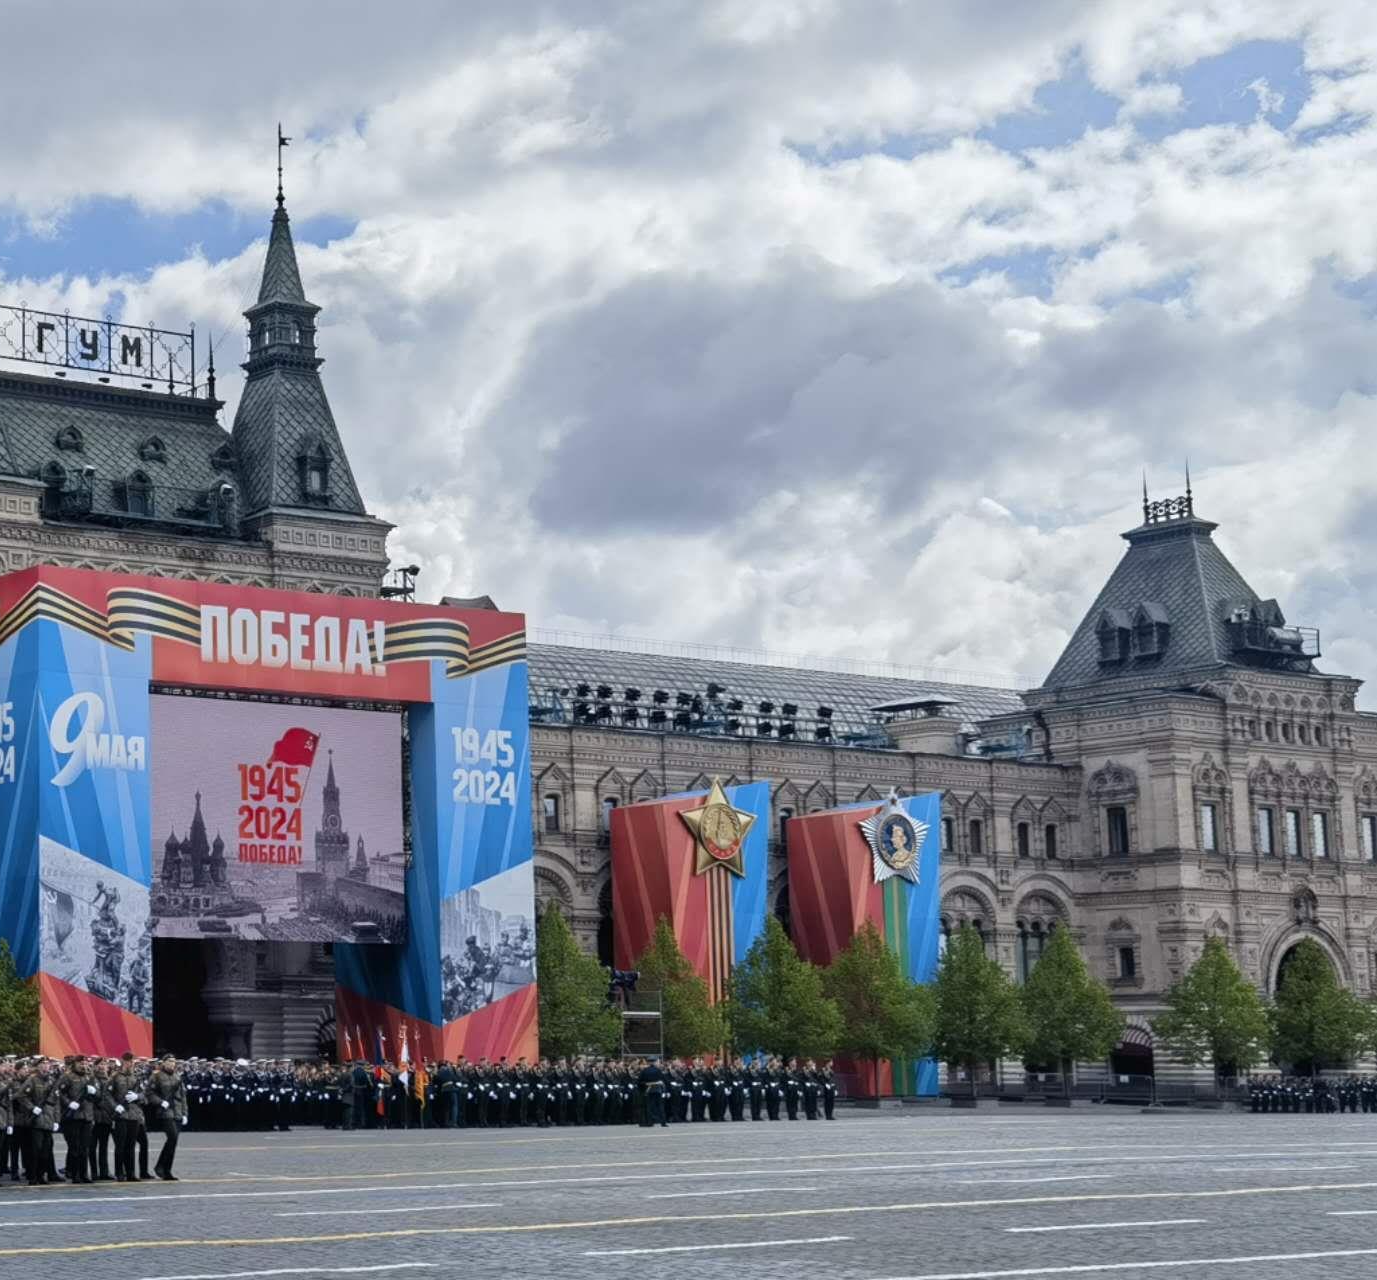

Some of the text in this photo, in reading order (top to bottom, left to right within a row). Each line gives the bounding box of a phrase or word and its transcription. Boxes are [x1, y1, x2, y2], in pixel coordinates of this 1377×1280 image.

[36, 321, 142, 367] ГУМ
[200, 604, 387, 677] ПОБЕДА!
[49, 691, 145, 787] 9 МАЯ
[451, 726, 515, 768] 1945
[237, 763, 302, 804] 1945
[452, 768, 516, 807] 2024
[238, 804, 302, 841] 2024
[239, 843, 303, 865] ПОБЕДА!
